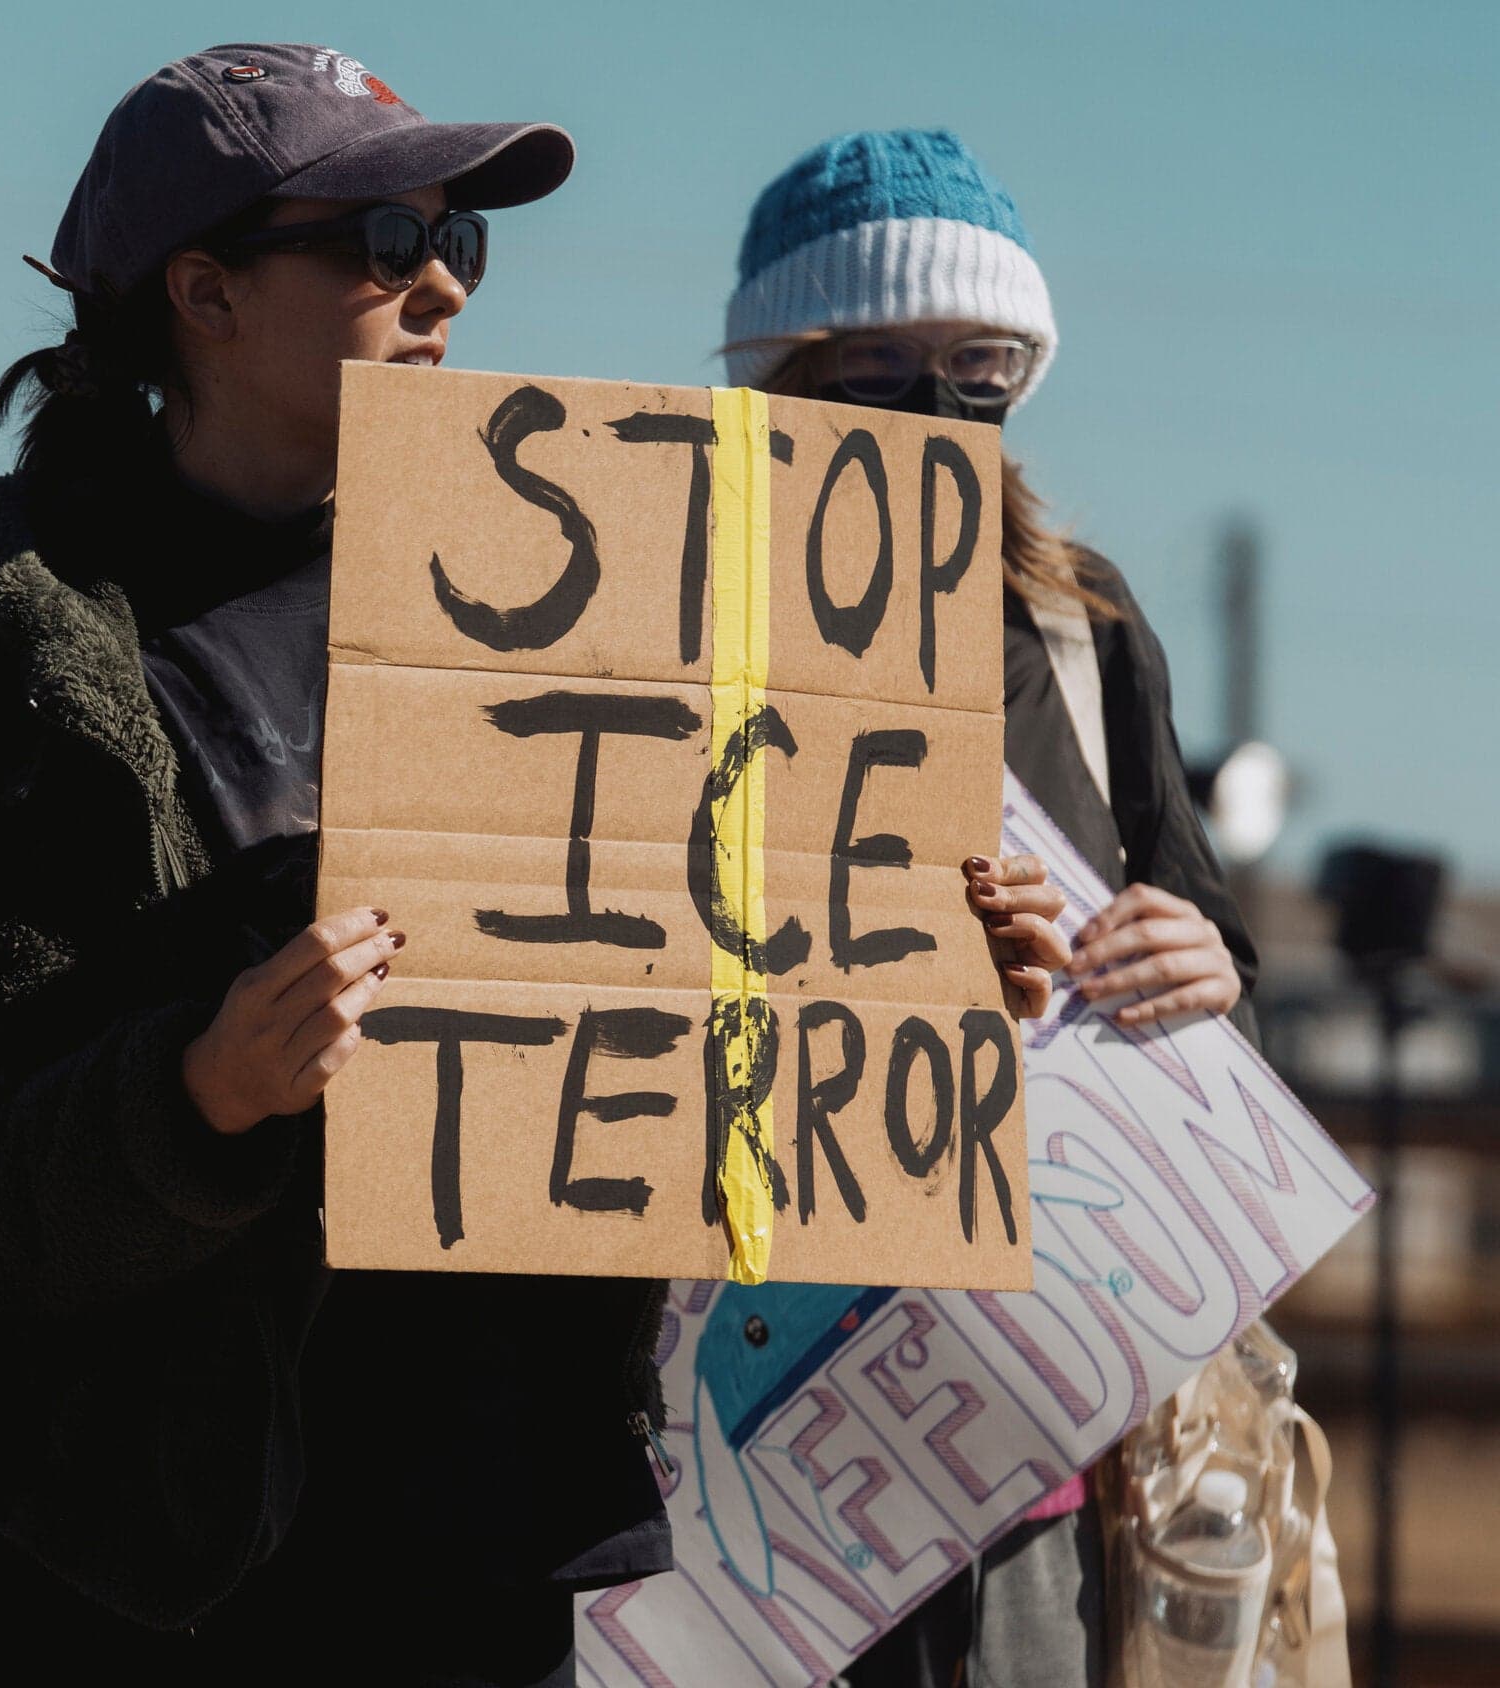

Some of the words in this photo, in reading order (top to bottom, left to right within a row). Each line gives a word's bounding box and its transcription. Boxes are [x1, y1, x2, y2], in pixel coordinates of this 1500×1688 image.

[430, 385, 982, 693] STOP
[473, 689, 937, 975] ICE
[359, 992, 1017, 1250] TERROR
